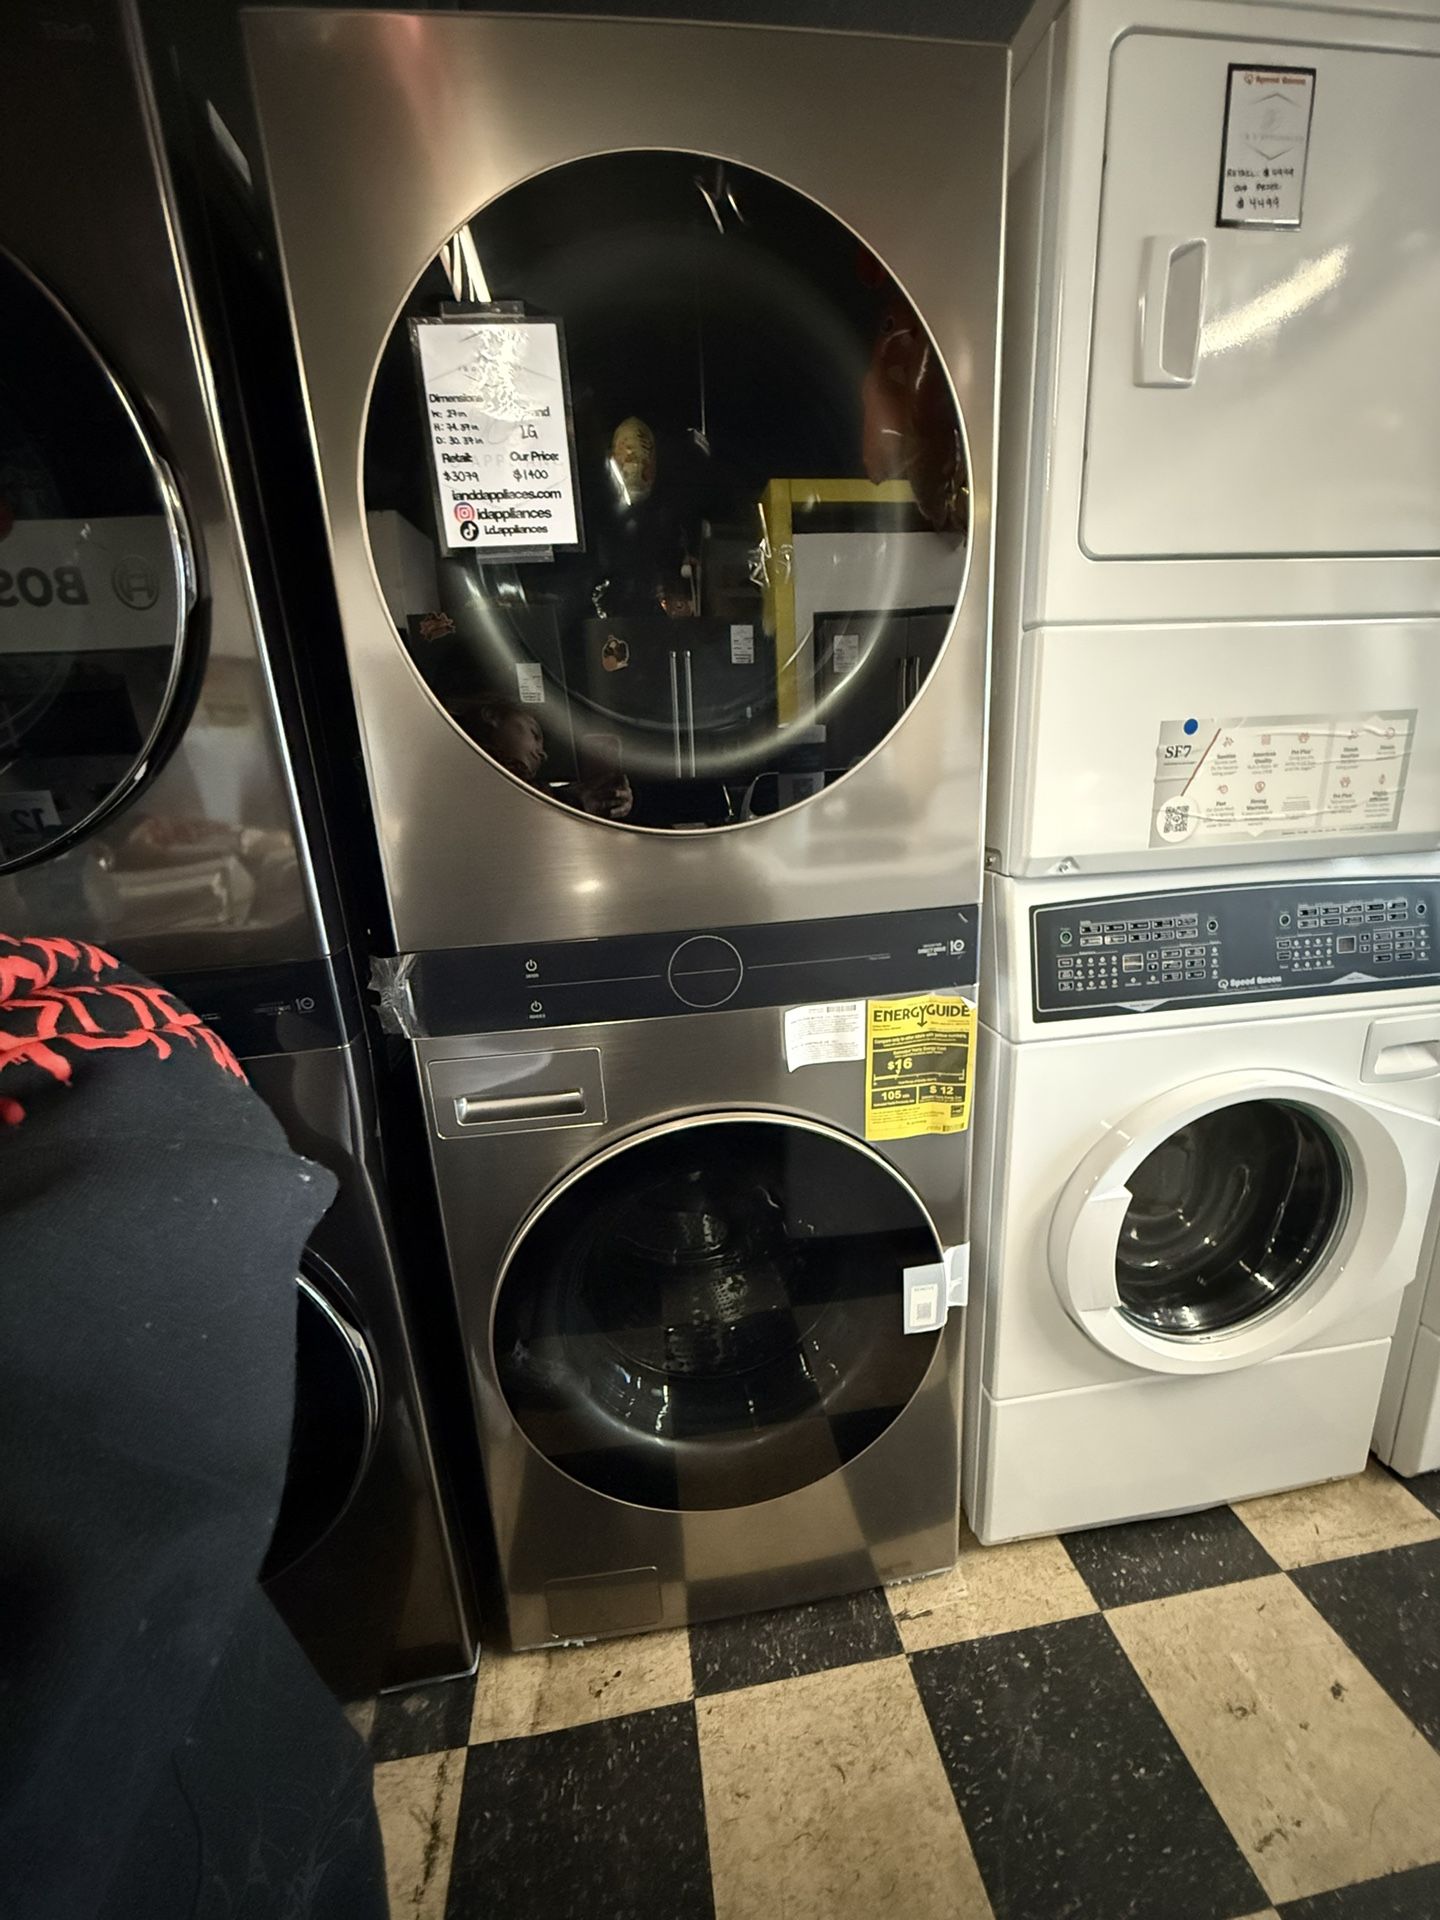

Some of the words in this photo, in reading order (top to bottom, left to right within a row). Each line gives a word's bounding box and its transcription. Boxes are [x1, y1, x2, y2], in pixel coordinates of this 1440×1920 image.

[519, 424, 538, 439] LG
[509, 451, 529, 461] Our
[531, 450, 559, 461] Price:
[513, 469, 548, 482] $1400
[1164, 744, 1192, 759] SF7
[1230, 977, 1255, 988] Speed
[1257, 976, 1282, 985] Queen
[887, 1058, 913, 1071] $16
[881, 1090, 901, 1101] 105
[940, 1086, 954, 1095] 12
